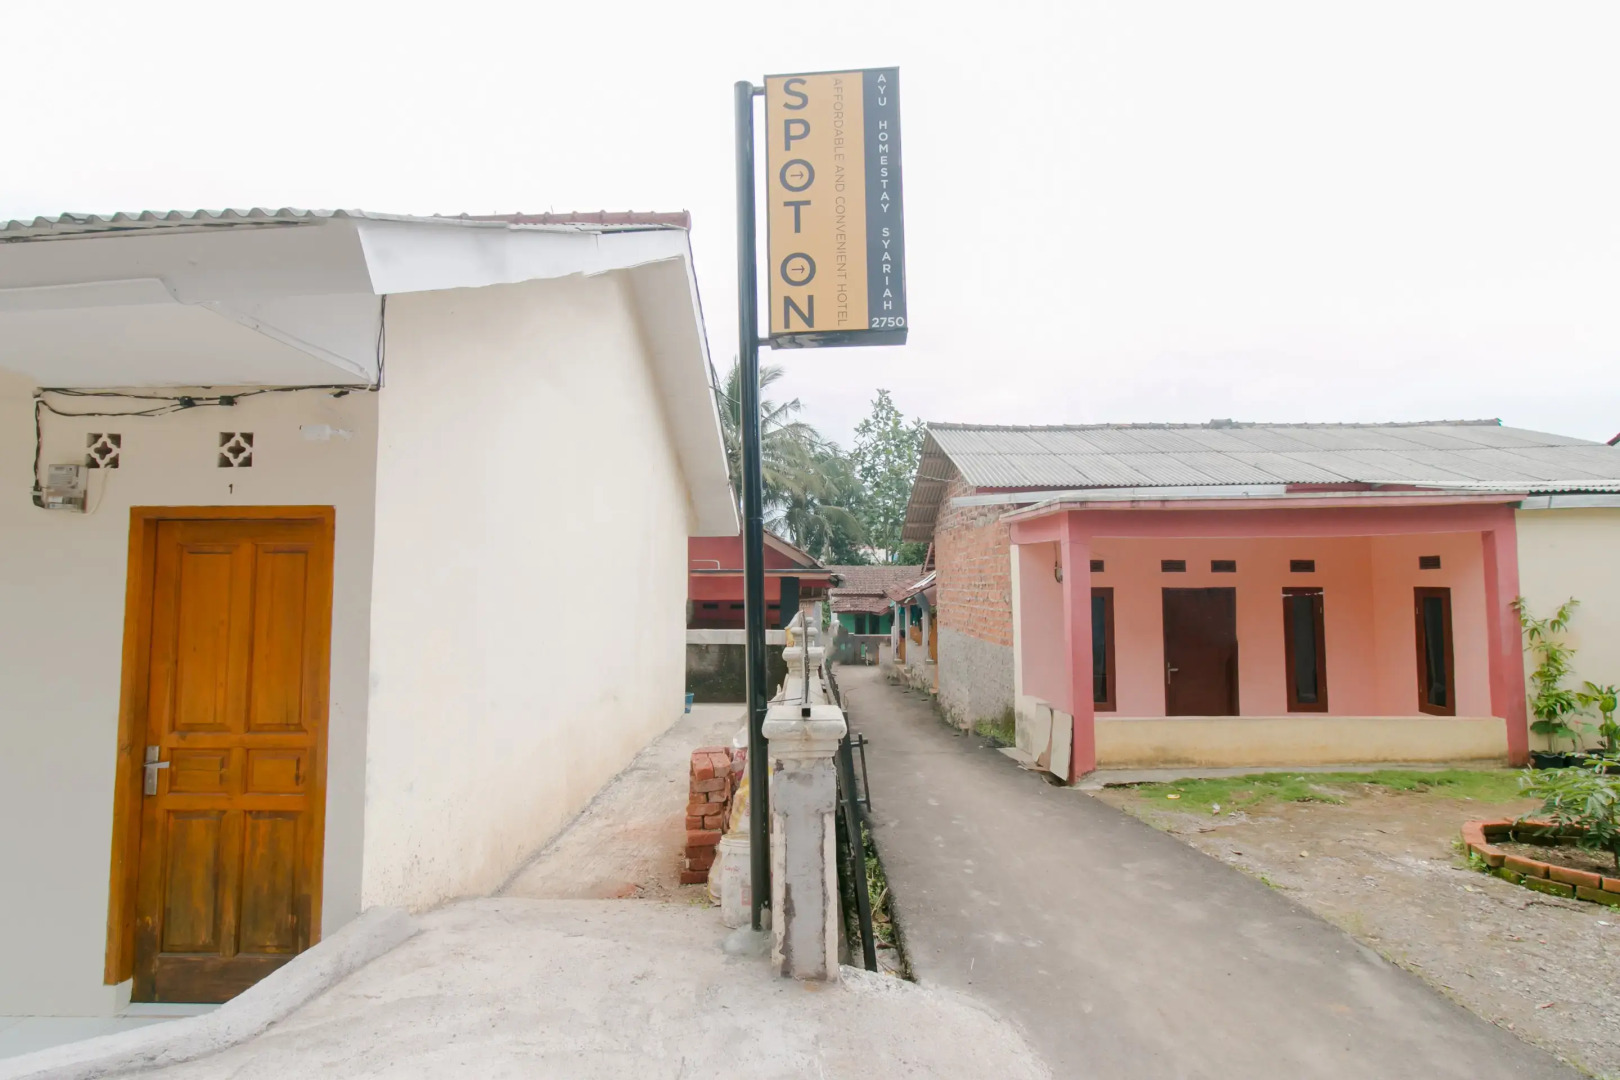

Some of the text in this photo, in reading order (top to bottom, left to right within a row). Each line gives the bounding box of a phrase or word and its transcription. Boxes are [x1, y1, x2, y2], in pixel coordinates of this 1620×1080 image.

[779, 78, 817, 330] SPOT ON
[832, 79, 848, 327] AFFORDABLE AND CONVENIENT HOTEL
[877, 73, 893, 310] AYU HOMESTAY SYARIAH
[871, 316, 905, 328] 2750
